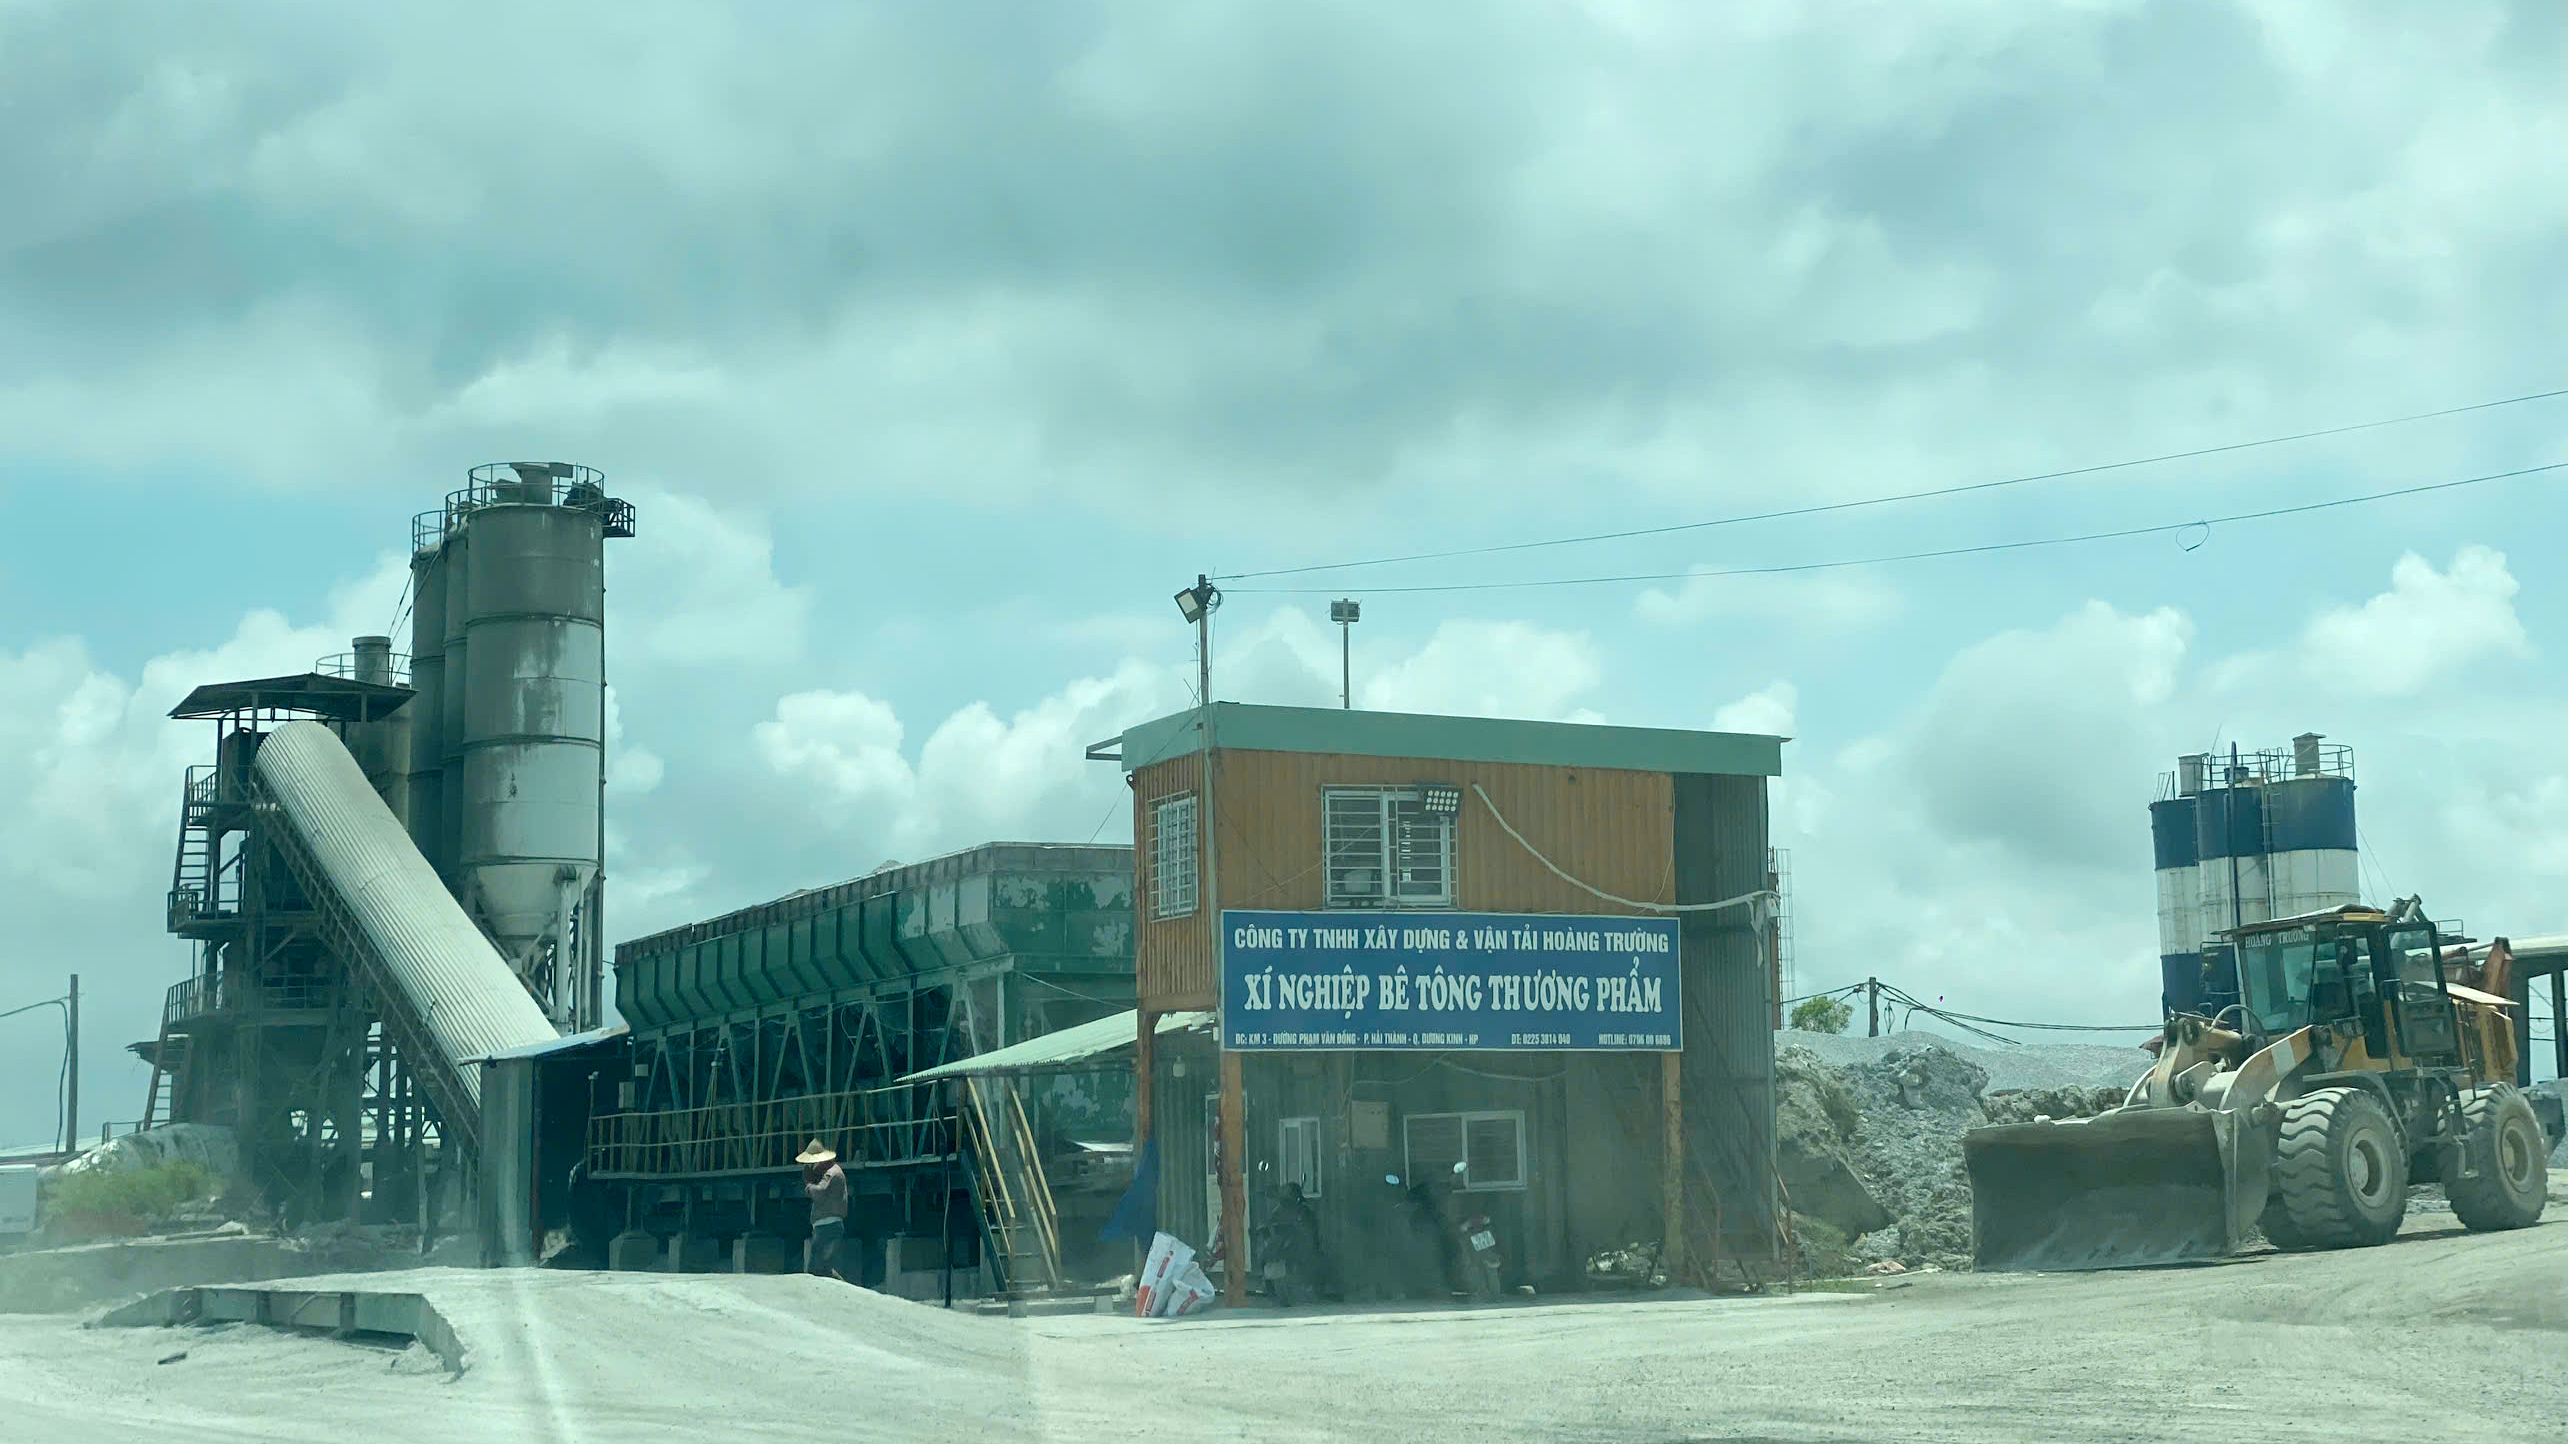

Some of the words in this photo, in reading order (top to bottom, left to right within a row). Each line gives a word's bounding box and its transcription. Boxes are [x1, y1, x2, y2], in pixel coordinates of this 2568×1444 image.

[1234, 924, 1283, 949] CÔNG
[1288, 929, 1308, 948] TY
[1313, 928, 1359, 949] TNHH
[1363, 925, 1398, 949] XÂY
[1403, 927, 1450, 953] DỰNG
[1456, 930, 1469, 950] &
[1474, 925, 1508, 953] VẬN
[1512, 923, 1538, 950] TẢI
[1543, 926, 1600, 951] HOÀNG
[1604, 926, 1669, 953] TRƯỜNG
[1244, 965, 1273, 1010] XÍ
[1278, 963, 1371, 1020] NGHIỆP
[1378, 964, 1410, 1011] BÊ
[1415, 964, 1483, 1011] TÔNG
[1488, 968, 1591, 1011] THƯƠNG
[1595, 955, 1662, 1013] PHẨM
[1248, 1033, 1261, 1045] KM
[1262, 1033, 1267, 1045] 3
[1446, 1032, 1463, 1045] KINH
[1522, 1033, 1540, 1045] 0225
